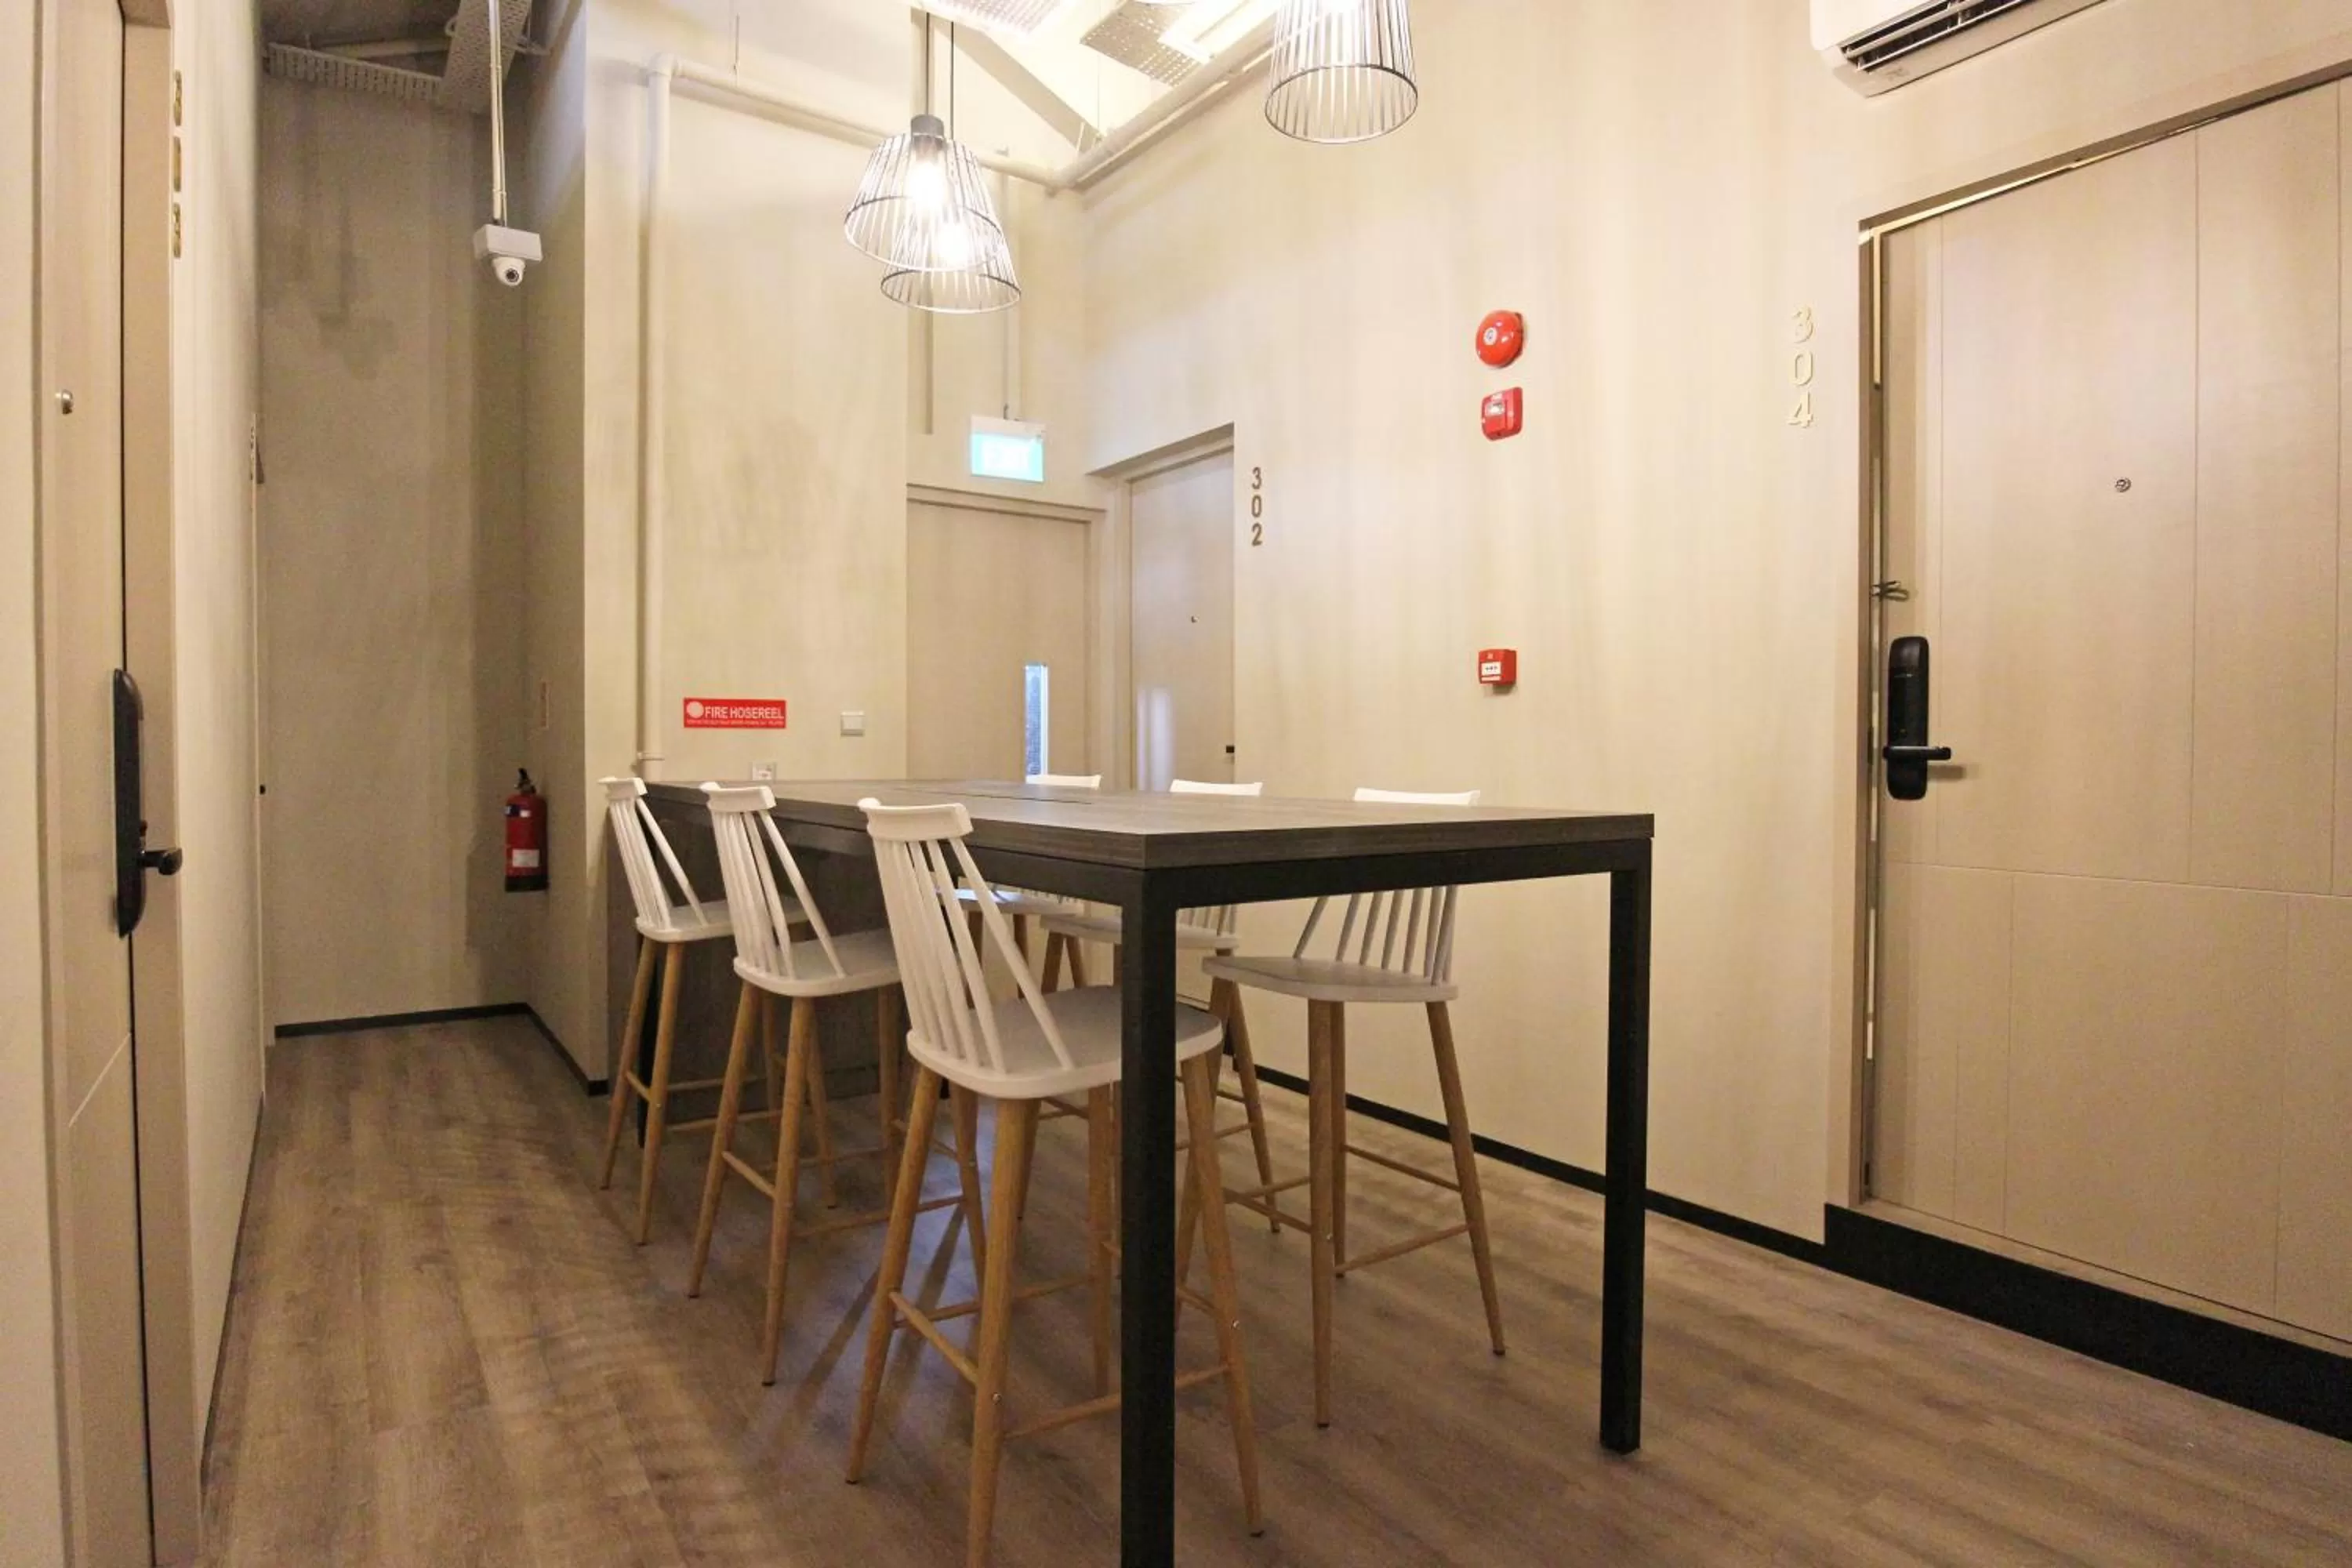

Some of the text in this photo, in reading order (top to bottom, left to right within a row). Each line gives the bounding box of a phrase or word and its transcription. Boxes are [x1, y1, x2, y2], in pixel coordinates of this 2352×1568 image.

[1788, 307, 1814, 429] 304
[1251, 466, 1262, 547] 302
[705, 706, 785, 719] FIRE HOSEREEL
